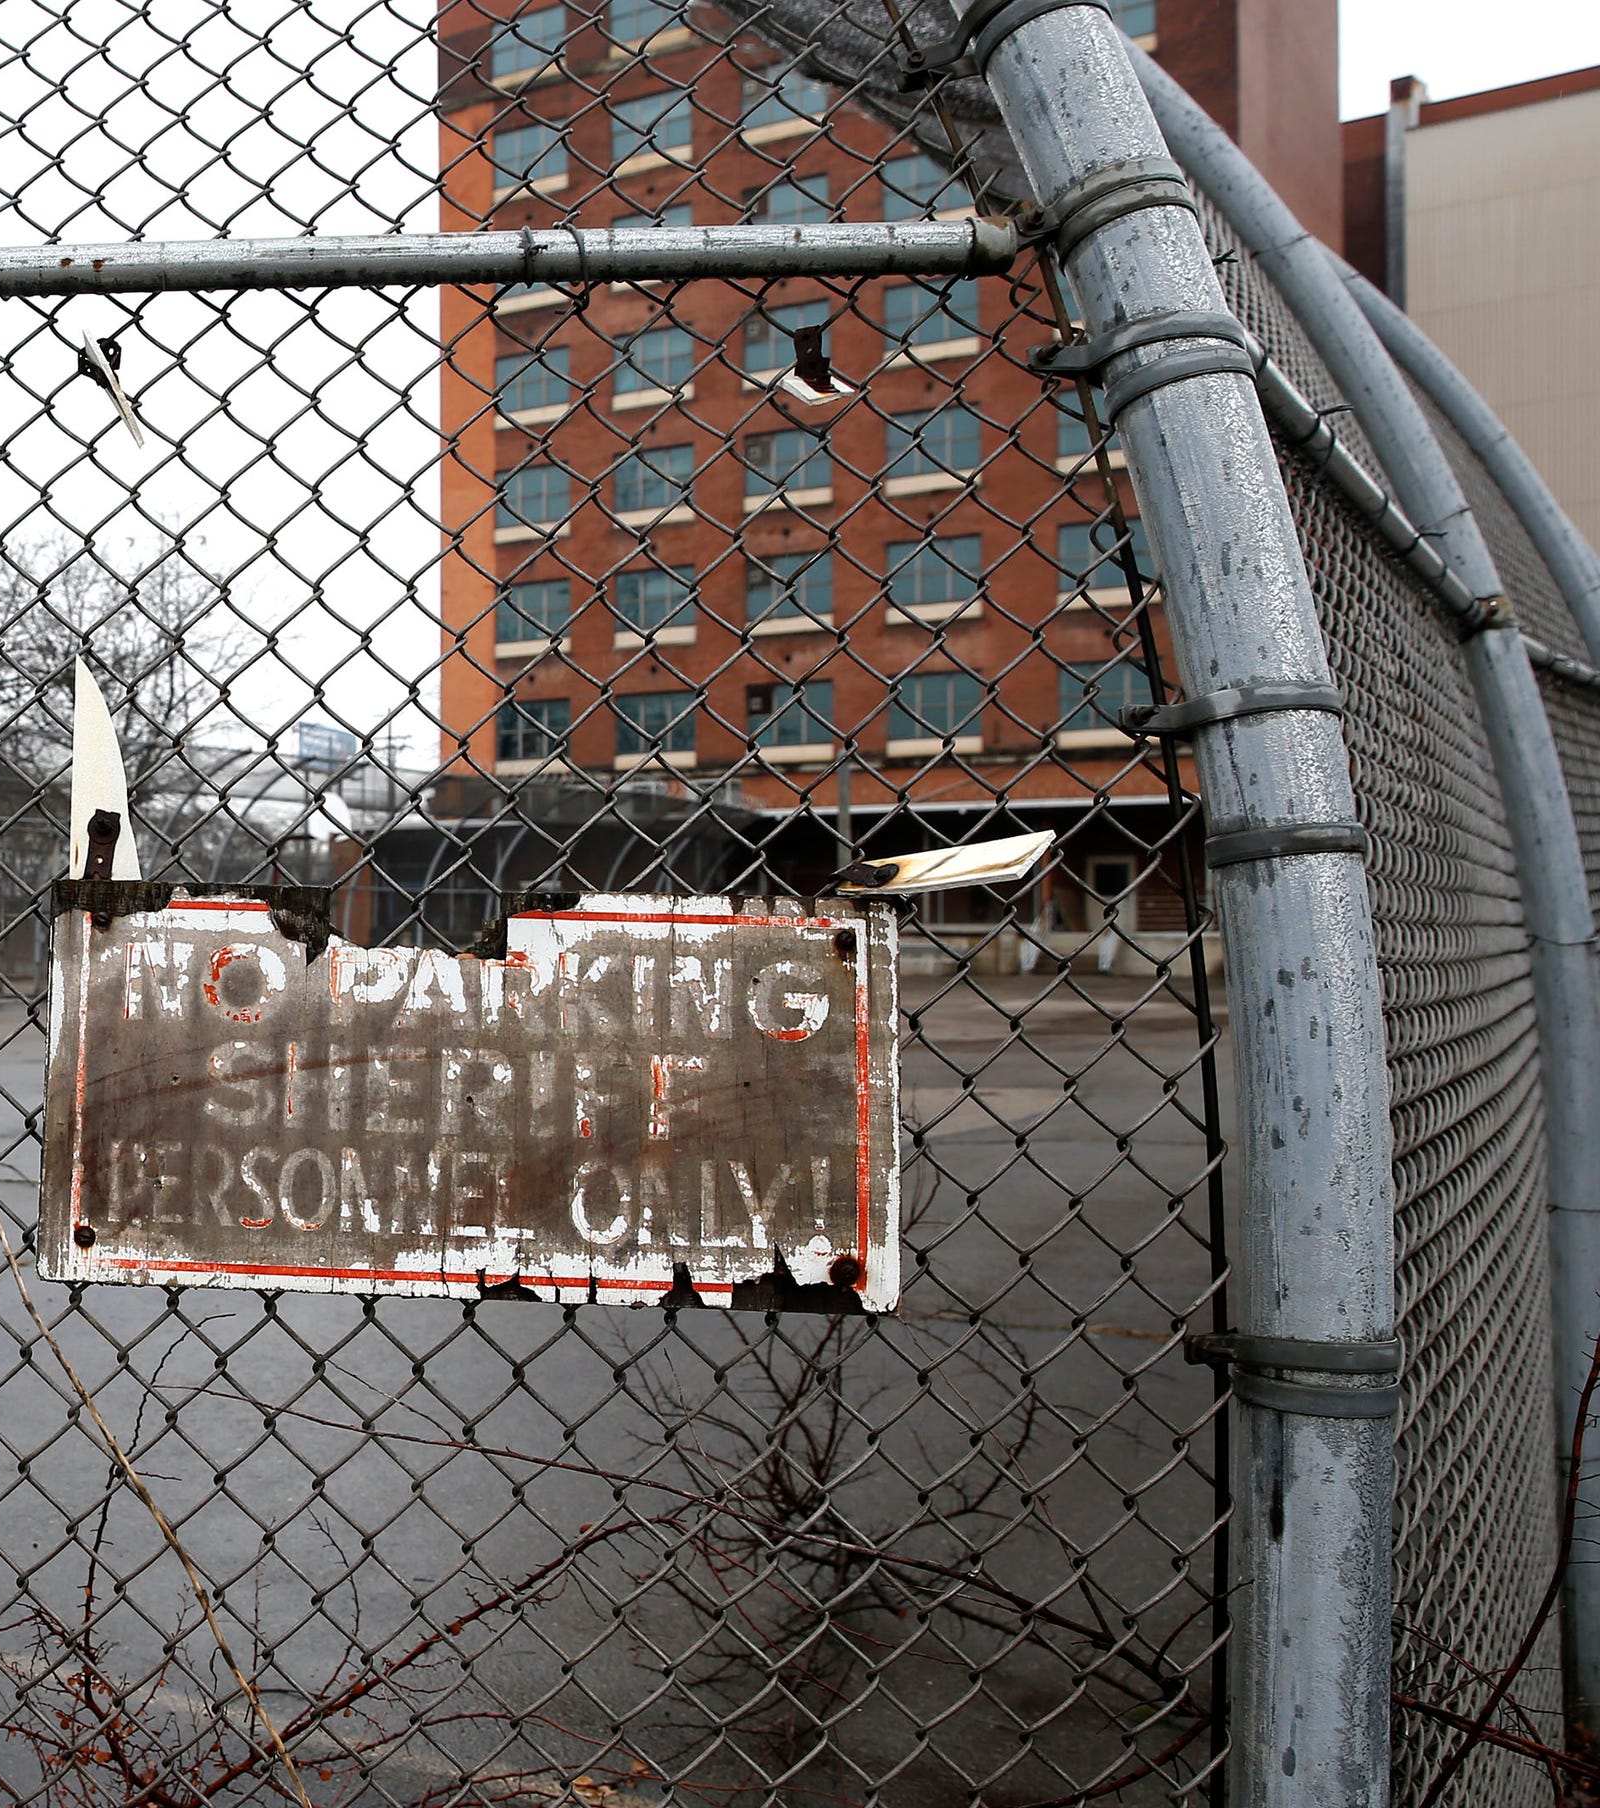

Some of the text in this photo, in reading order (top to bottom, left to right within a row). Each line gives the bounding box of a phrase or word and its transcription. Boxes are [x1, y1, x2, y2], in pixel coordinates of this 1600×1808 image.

[123, 941, 830, 1042] NO PARKING
[570, 1154, 833, 1256] ONLY!
